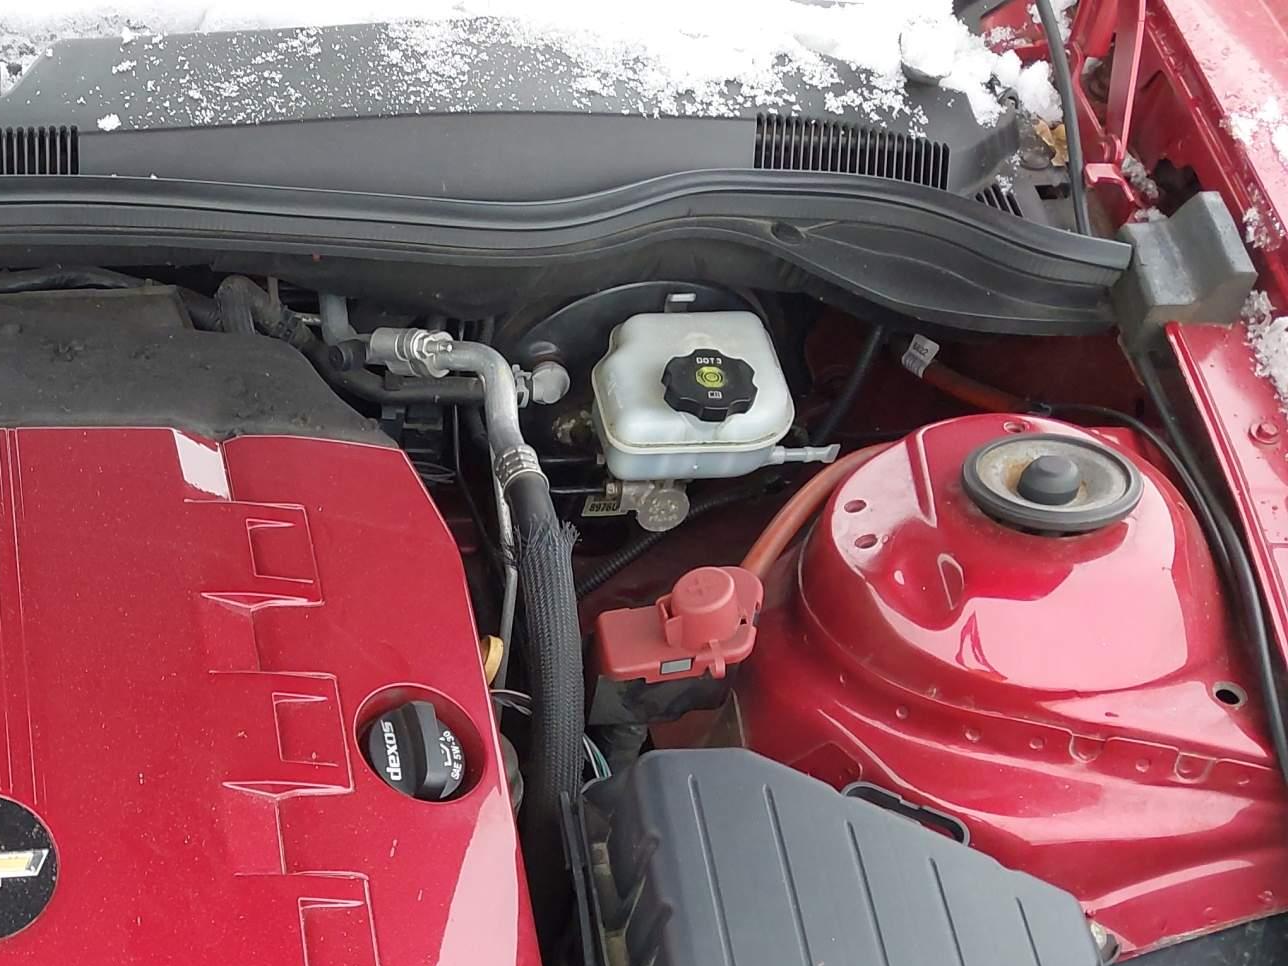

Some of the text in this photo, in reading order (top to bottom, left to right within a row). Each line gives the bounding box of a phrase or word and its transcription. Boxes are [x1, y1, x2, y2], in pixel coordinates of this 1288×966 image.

[380, 720, 402, 781] dexos
[442, 730, 463, 780] SAE 5W-30
